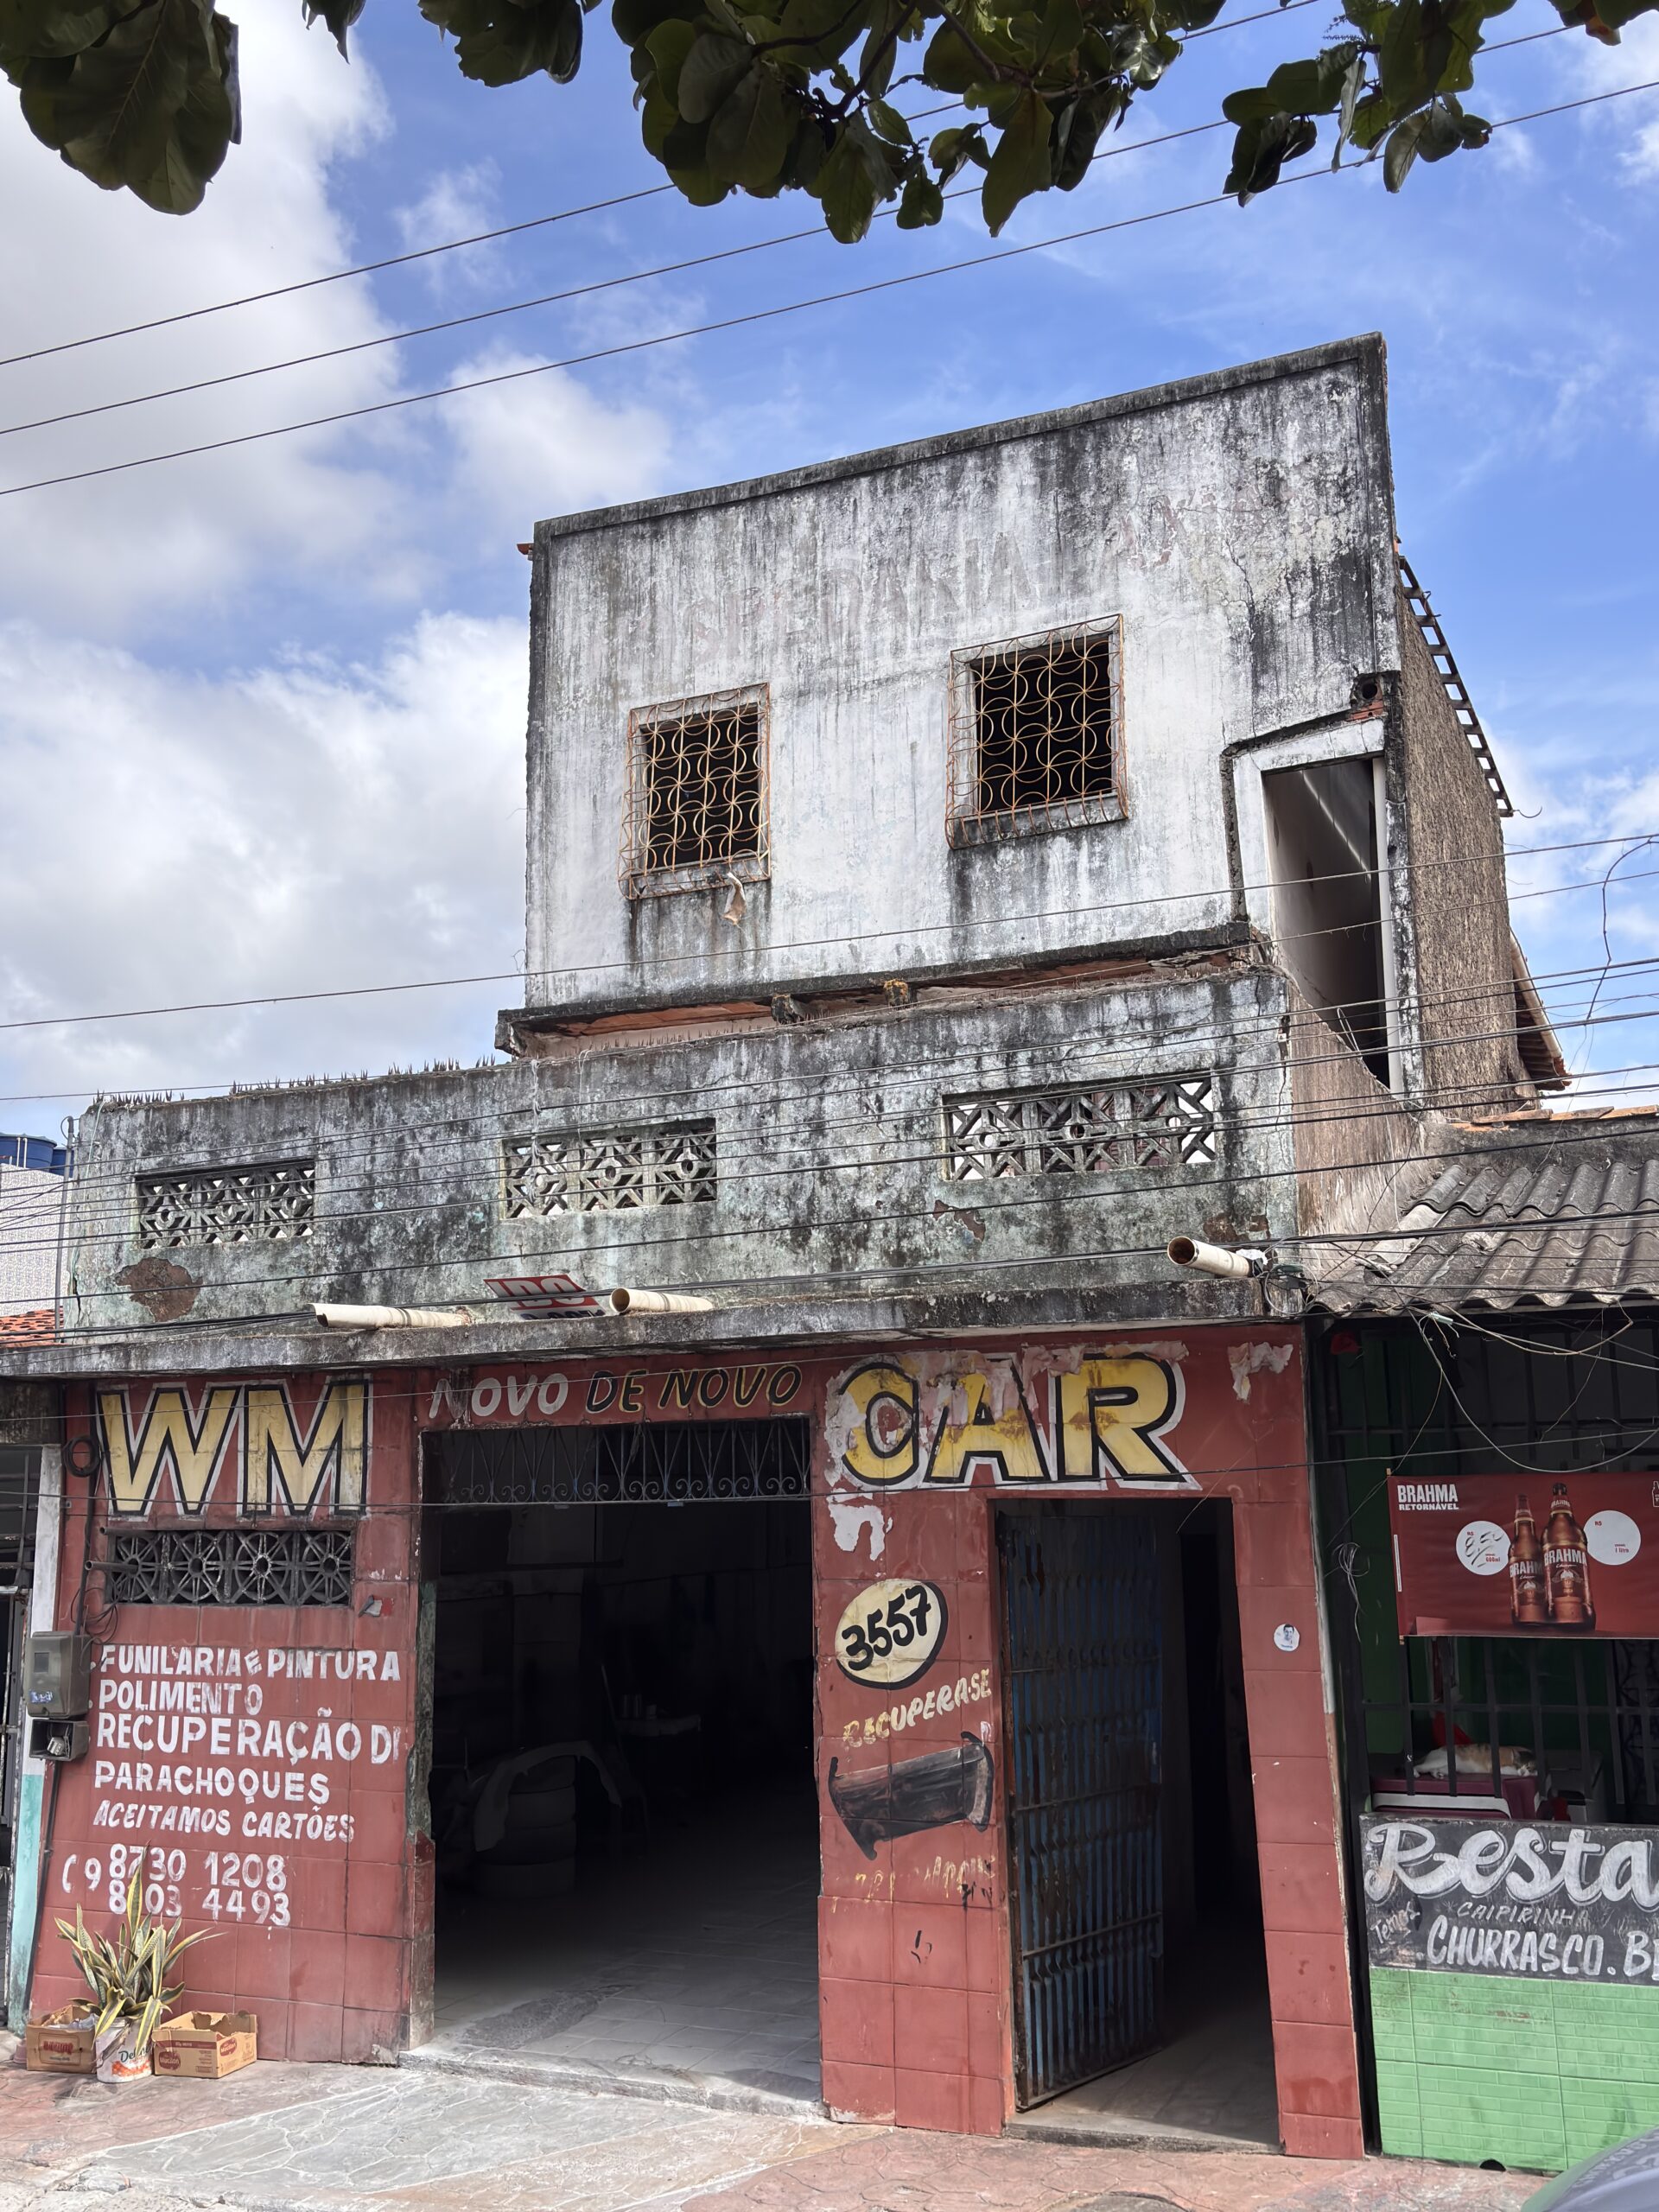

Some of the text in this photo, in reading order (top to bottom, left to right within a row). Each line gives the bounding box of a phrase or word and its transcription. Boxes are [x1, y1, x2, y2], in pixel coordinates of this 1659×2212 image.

[428, 1364, 803, 1418] NOVO DE NOVO
[836, 1353, 1202, 1491] CAR
[95, 1378, 372, 1519] WM
[1396, 1484, 1459, 1503] BRAHMA
[1398, 1502, 1459, 1511] RETORNÁVEL
[1543, 1548, 1588, 1567] BRAHMA
[842, 1585, 932, 1672] 3557
[100, 1644, 242, 1676] FUNILARIA
[267, 1648, 402, 1681] PINTURA
[99, 1679, 264, 1716] POLIMENTO
[97, 1707, 362, 1766] RECUPERAÇÃO
[94, 1759, 330, 1804] PARACHOQUES
[93, 1799, 355, 1843] ACEITAMOS CARTÕES
[205, 1850, 288, 1892] 1208
[109, 1879, 291, 1928] 803 4493
